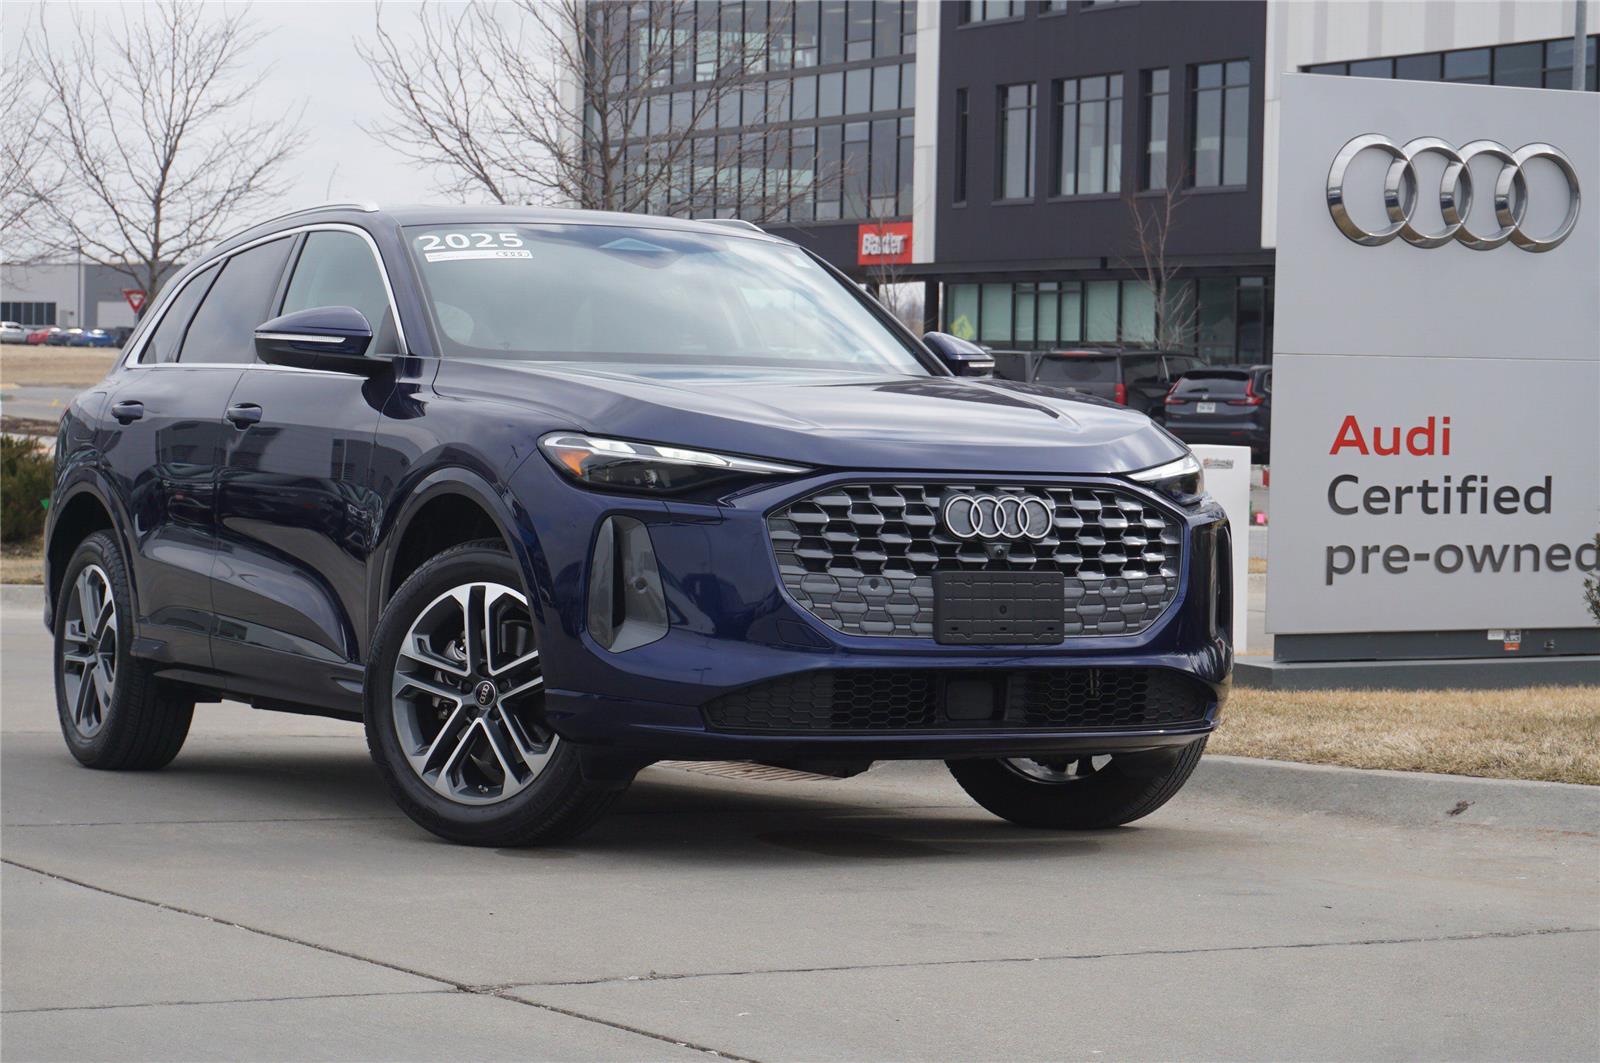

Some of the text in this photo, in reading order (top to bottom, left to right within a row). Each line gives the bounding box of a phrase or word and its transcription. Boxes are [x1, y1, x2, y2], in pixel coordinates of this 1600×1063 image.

[418, 232, 524, 251] 2025
[1329, 415, 1451, 456] Audi
[1327, 474, 1553, 515] Certified
